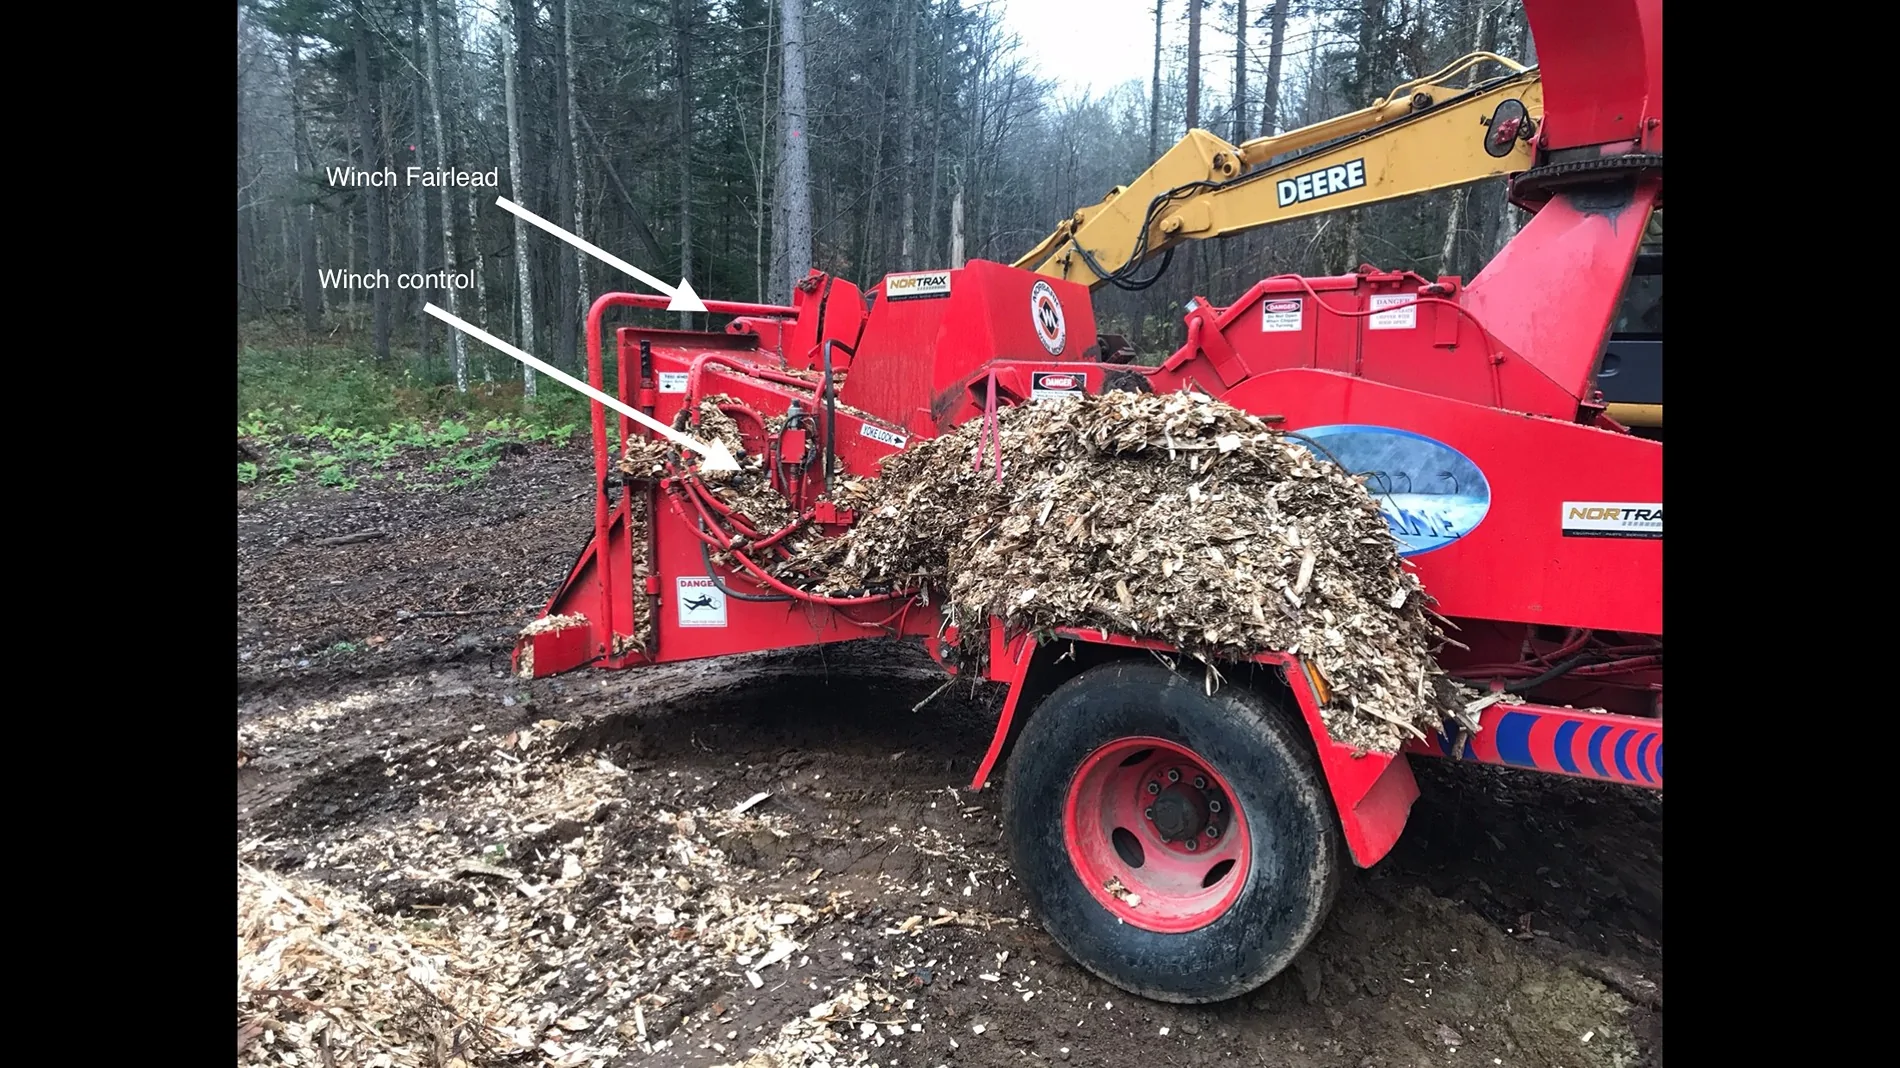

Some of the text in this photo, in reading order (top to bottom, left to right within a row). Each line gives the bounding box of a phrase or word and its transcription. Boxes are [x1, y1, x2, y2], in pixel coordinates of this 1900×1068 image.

[1277, 159, 1365, 207] DEERE
[890, 276, 947, 289] NORTRAX
[1045, 378, 1073, 387] DANGER
[863, 425, 893, 443] YOKE LOCK
